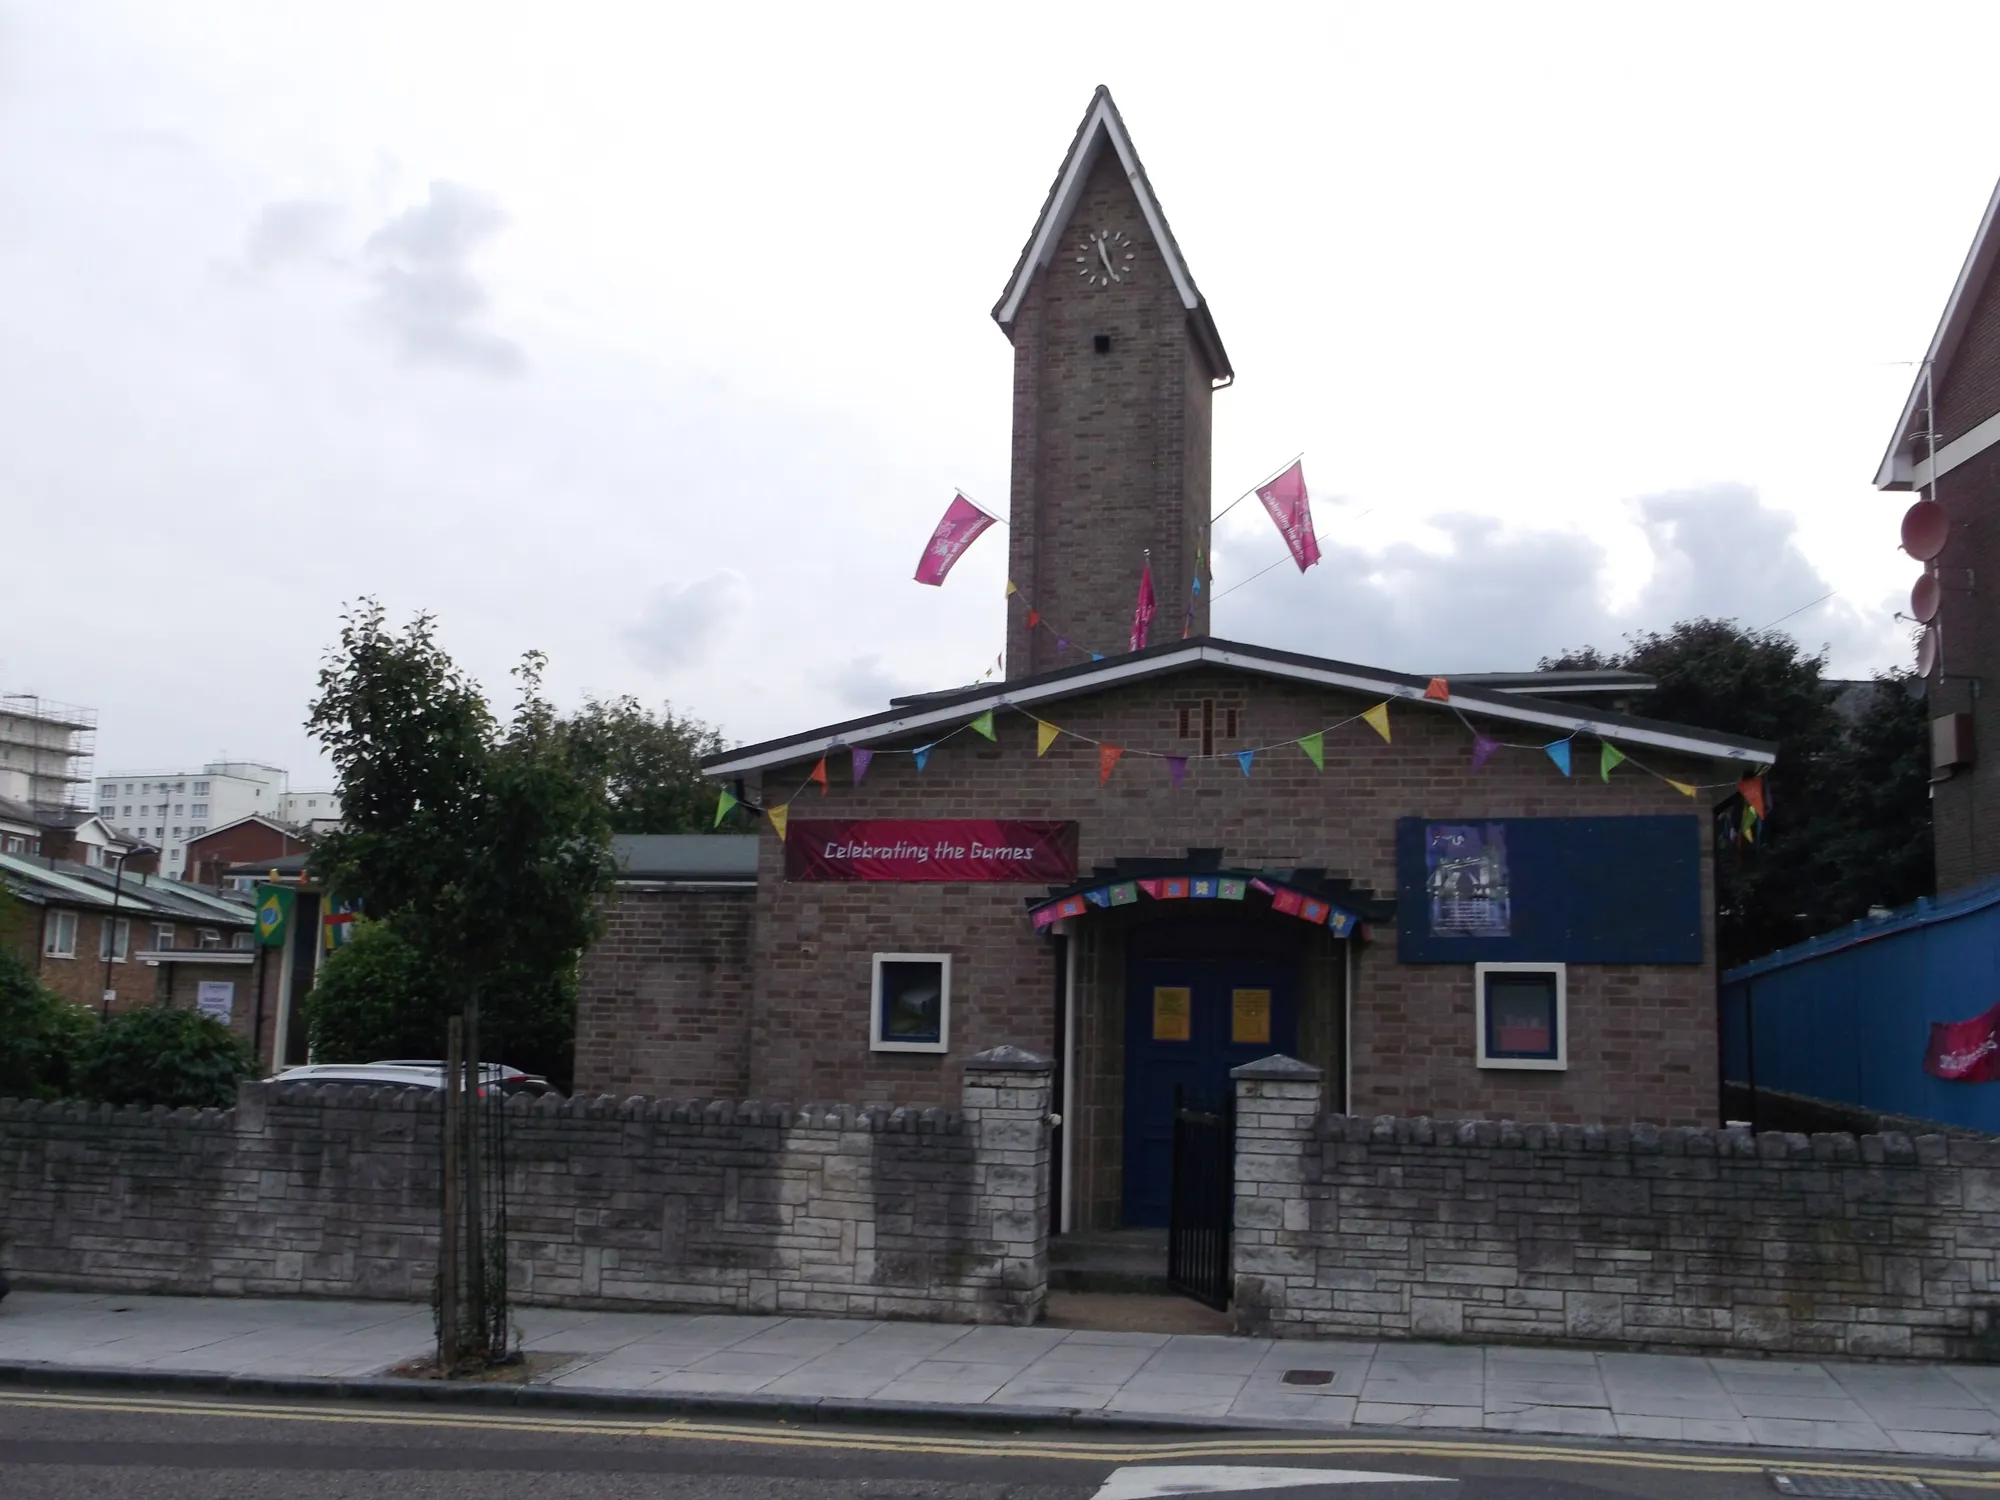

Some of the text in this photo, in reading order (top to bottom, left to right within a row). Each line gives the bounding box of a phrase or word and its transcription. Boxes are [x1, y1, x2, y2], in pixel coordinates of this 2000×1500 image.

[824, 840, 1034, 863] Celebrating the Games
